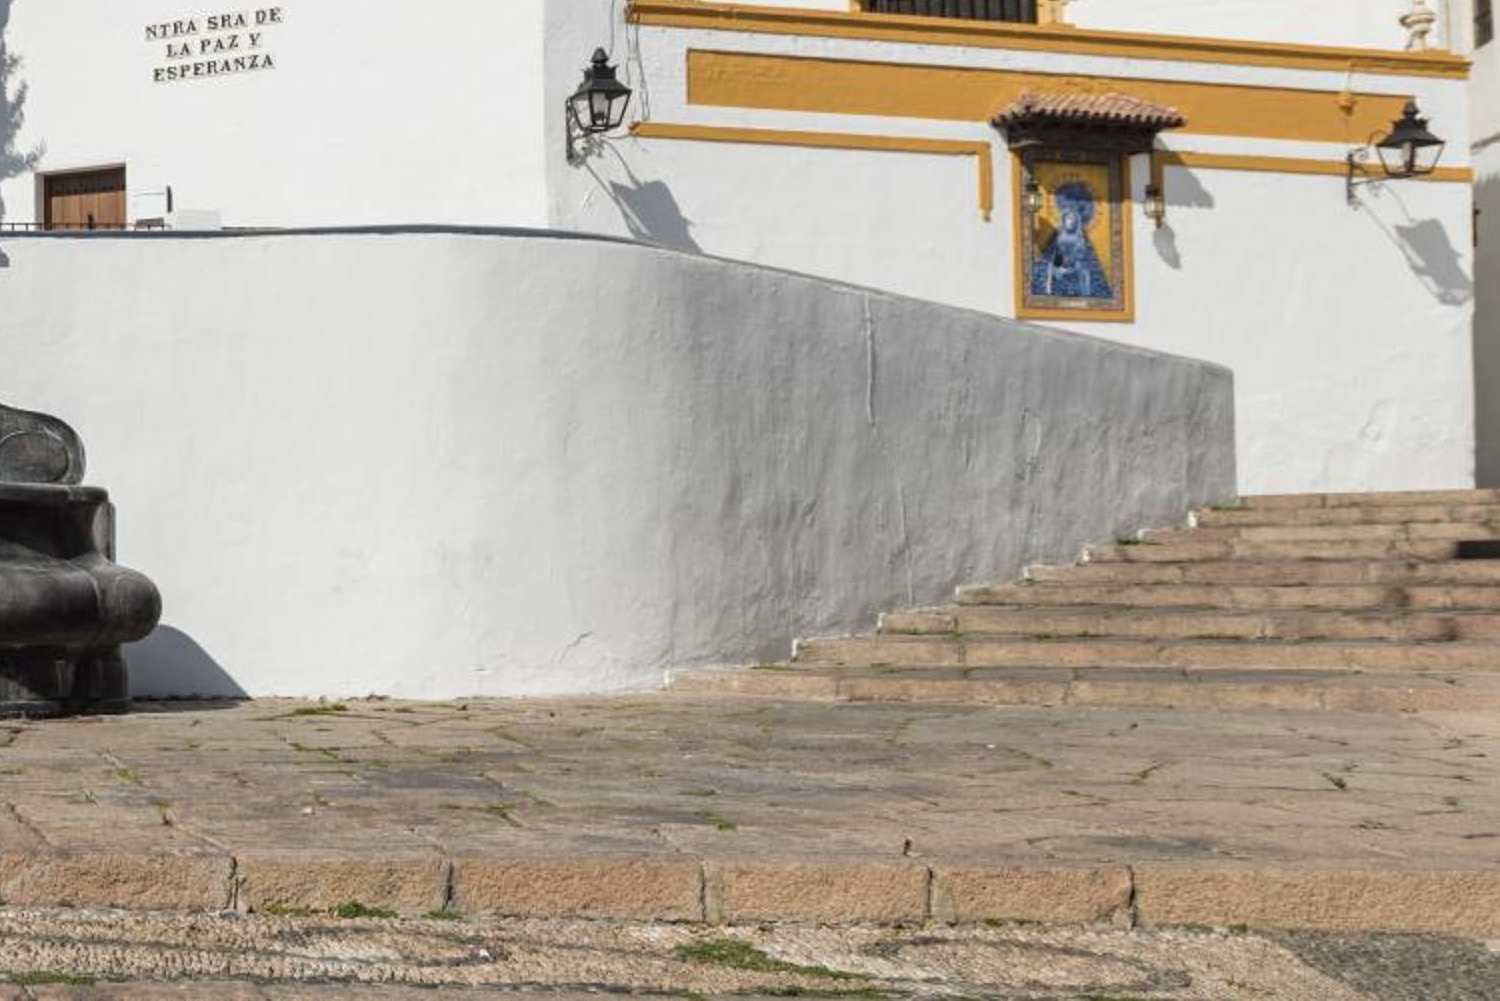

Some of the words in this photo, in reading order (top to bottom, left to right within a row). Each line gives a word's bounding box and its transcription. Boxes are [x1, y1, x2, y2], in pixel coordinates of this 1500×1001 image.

[145, 19, 197, 40] NTRA
[206, 12, 246, 31] SRA
[254, 6, 283, 24] DE
[165, 42, 191, 58] LA
[200, 34, 240, 54] PAZ
[248, 32, 261, 47] Y
[153, 54, 274, 82] ESPERANZA
